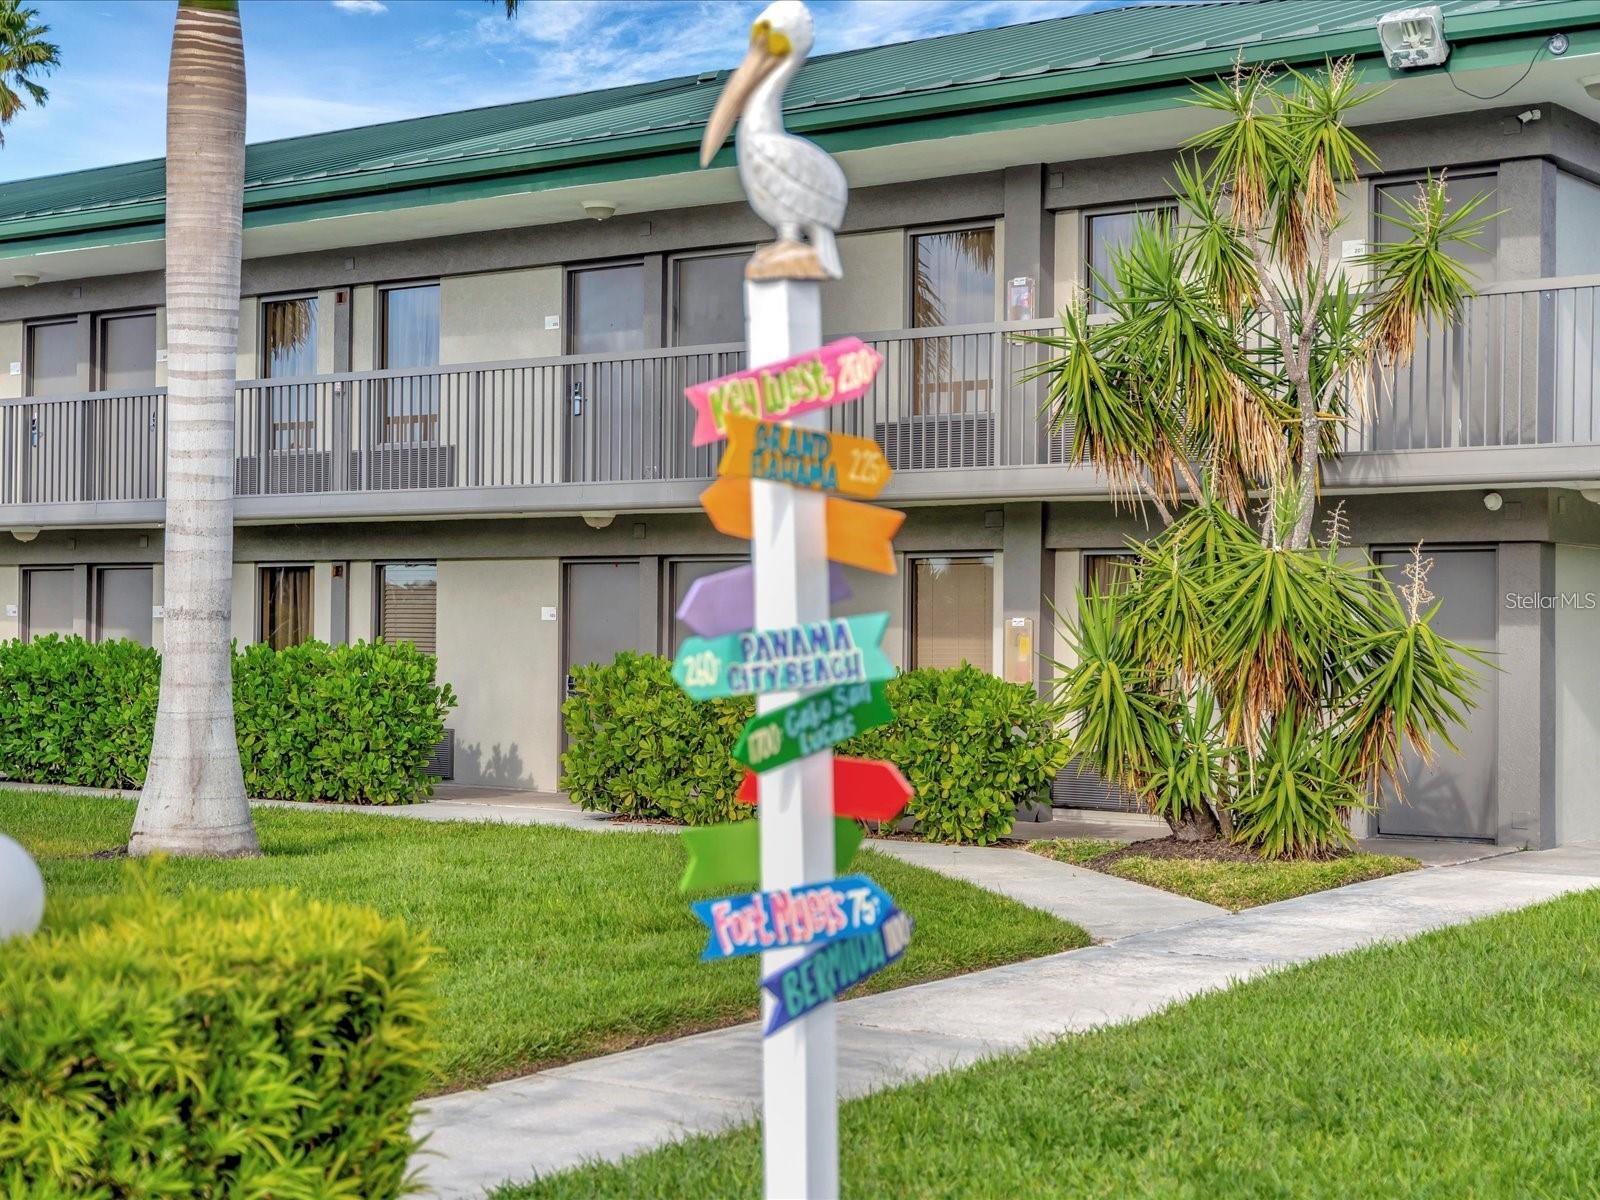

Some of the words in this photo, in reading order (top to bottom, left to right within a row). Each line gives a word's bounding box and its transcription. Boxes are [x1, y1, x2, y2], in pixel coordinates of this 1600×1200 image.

[756, 423, 832, 460] GRAND
[848, 449, 882, 484] 225
[740, 618, 855, 663] PANAMA
[728, 660, 782, 692] CITY
[785, 650, 867, 689] BEACH
[711, 894, 775, 955] Fort
[768, 886, 849, 946] Myers
[781, 930, 886, 1017] BERMUDA
